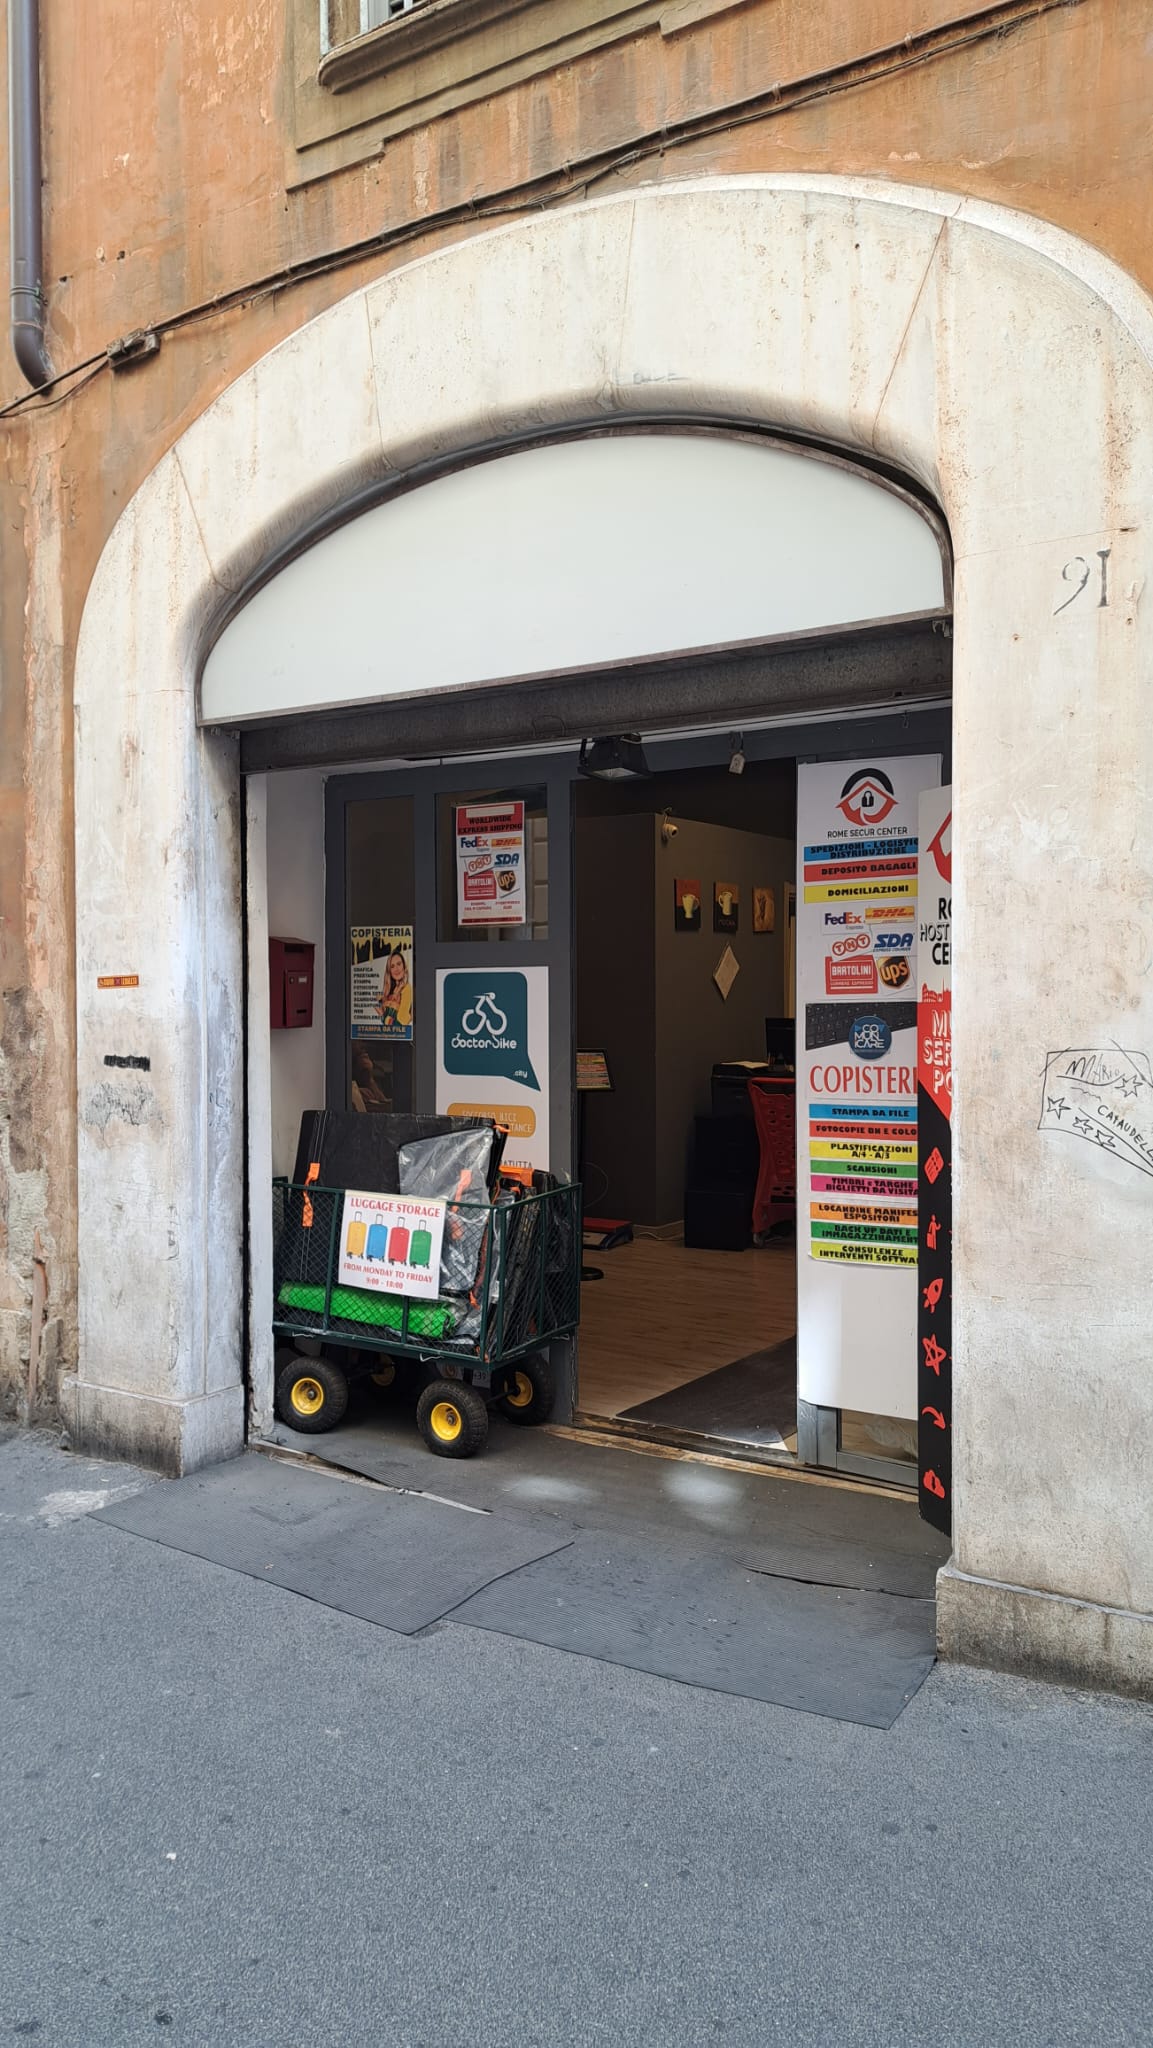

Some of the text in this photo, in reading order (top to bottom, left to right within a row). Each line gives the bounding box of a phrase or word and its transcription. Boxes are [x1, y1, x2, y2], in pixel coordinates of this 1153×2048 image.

[1053, 549, 1111, 616] 91
[827, 826, 908, 838] ROME SECUR CENTER
[460, 836, 489, 848] FedEx
[810, 842, 865, 854] SPEDIZIONI
[873, 837, 919, 849] LOGISTIC
[830, 847, 907, 859] DISTRIBUZIONE
[495, 853, 519, 866] SDA
[821, 861, 917, 876] DEPOSITO BAGAGLI
[499, 871, 515, 888] ups
[828, 885, 909, 896] DOMICILIAZIONI
[824, 912, 863, 925] FedEx
[351, 928, 412, 938] COPISTERIA
[919, 923, 950, 942] HOST
[832, 934, 871, 956] TNT
[874, 932, 914, 948] SDA
[831, 965, 871, 976] BARTOLINI
[880, 961, 909, 983] ups
[809, 1066, 918, 1094] COPISTERI
[832, 1108, 910, 1117] STAMPA DA FILE
[508, 1122, 532, 1133] TANCE
[816, 1125, 865, 1134] FOTOCOPIE
[883, 1127, 889, 1135] E
[892, 1128, 918, 1136] COLO
[830, 1143, 913, 1153] PLASTIFICAZIONI
[846, 1165, 897, 1174] SCANSIONI
[832, 1177, 865, 1186] TIMBRI
[874, 1180, 914, 1188] TARGHE
[825, 1184, 870, 1193] BIGLIETTI
[872, 1186, 886, 1194] DA
[350, 1198, 441, 1218] LUGGAGE STORAGE
[818, 1205, 918, 1217] LOCANDINE MANIFES
[844, 1213, 900, 1222] ESPOSITORI
[822, 1230, 918, 1242] IMMAGAZZINAMENT
[835, 1225, 862, 1233] BACK
[879, 1228, 903, 1236] DATI
[842, 1245, 904, 1256] CONSULENZE
[819, 1250, 918, 1264] INTERVENTI SOFTWA
[343, 1262, 433, 1283] FROM MONDAY TO FRIDAY
